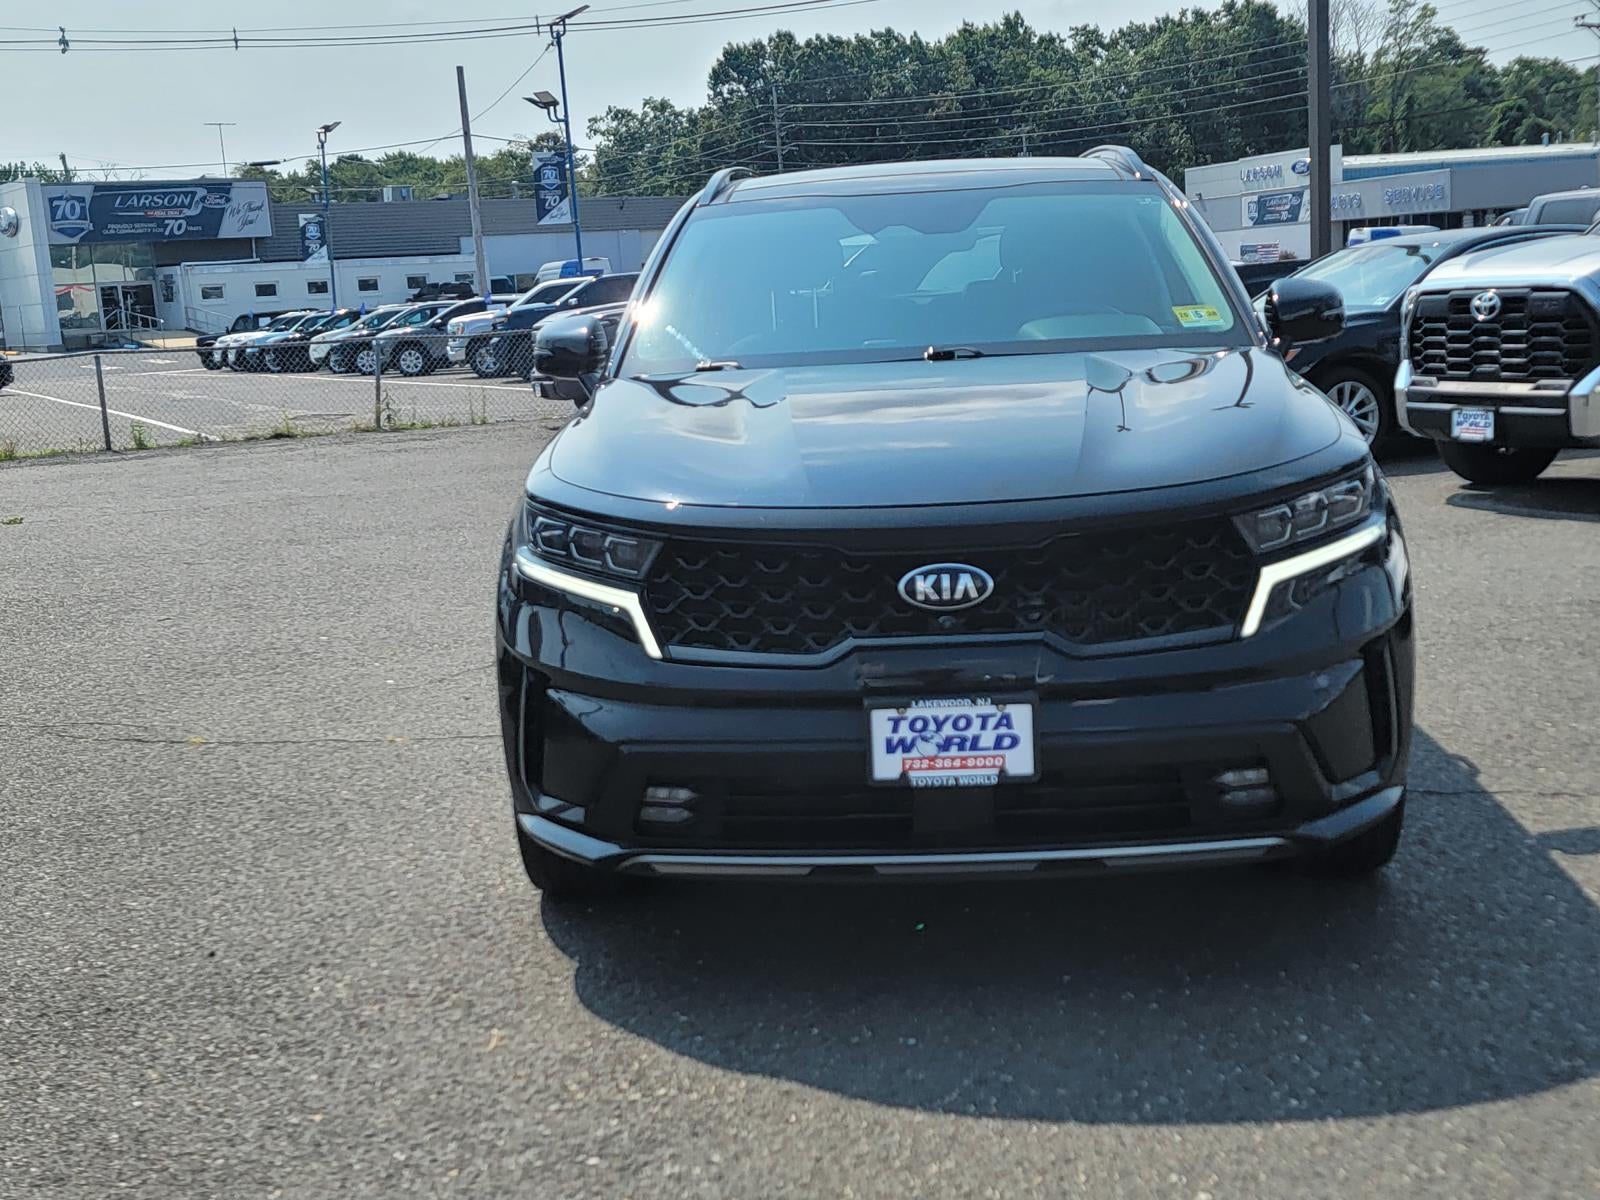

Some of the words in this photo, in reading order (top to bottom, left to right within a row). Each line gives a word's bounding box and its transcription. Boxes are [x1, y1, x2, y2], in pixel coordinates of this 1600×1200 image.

[543, 169, 556, 179] 70
[114, 193, 191, 208] LARSON
[204, 194, 226, 204] Ford
[1384, 184, 1445, 205] SERVICE
[545, 195, 560, 209] 70
[52, 199, 80, 220] 70
[226, 203, 240, 217] We
[163, 219, 186, 235] 70
[1456, 411, 1490, 420] TOYOTA
[915, 573, 979, 601] KIA
[911, 698, 974, 708] LAKEWOOD,
[975, 697, 992, 706] NJ
[887, 712, 1015, 734] TOYOTA
[885, 731, 1022, 755] WORLD
[904, 757, 1004, 769] 732-364-9000
[911, 775, 957, 785] TOYOTA
[958, 774, 998, 784] WORLD
